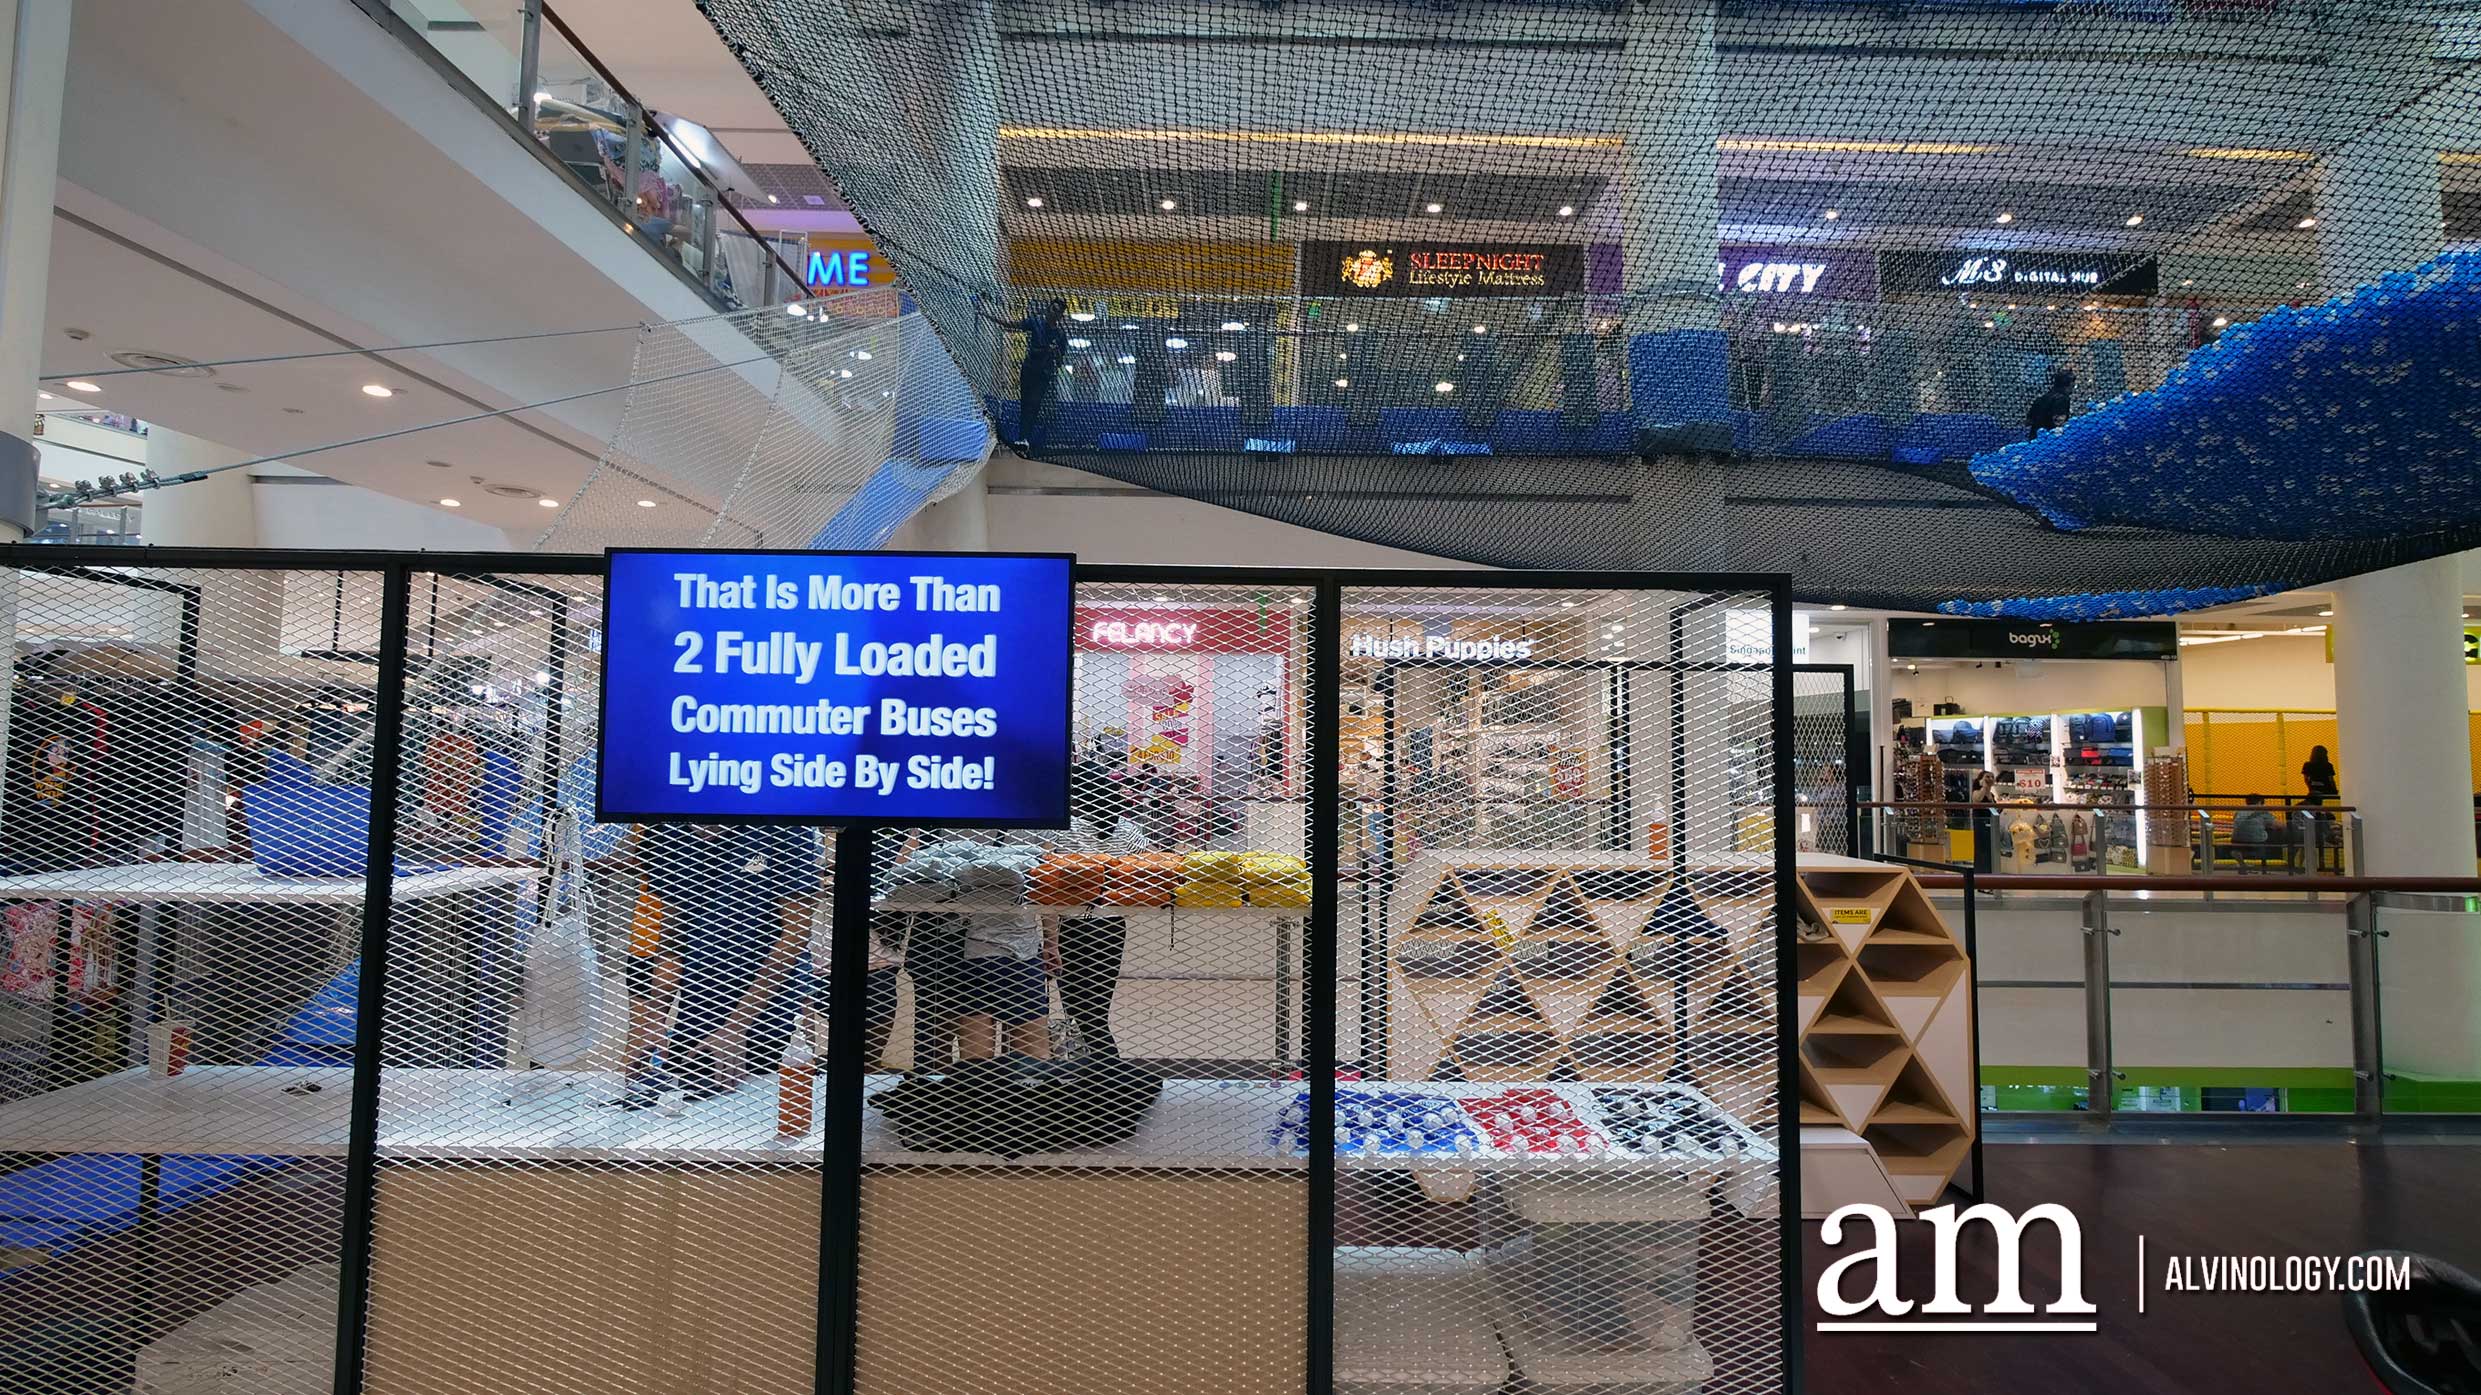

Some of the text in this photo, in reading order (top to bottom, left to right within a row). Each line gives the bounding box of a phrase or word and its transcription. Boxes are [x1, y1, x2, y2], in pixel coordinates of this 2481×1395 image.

[807, 250, 870, 286] ME
[1409, 251, 1544, 271] SLEEPNIGHT
[1409, 270, 1545, 288] Lifestyle Mattress
[1738, 263, 1827, 292] CITY
[2014, 271, 2067, 283] DIGITAL
[2071, 271, 2099, 283] HUB
[673, 573, 1001, 613] That Is More Than
[1093, 621, 1197, 644] FELANCY
[1351, 634, 1532, 660] Hush Puppies
[673, 631, 997, 685] 2 Fully Loaded
[671, 695, 998, 738] Commuter Buses
[668, 752, 995, 796] Lying Side By Side!
